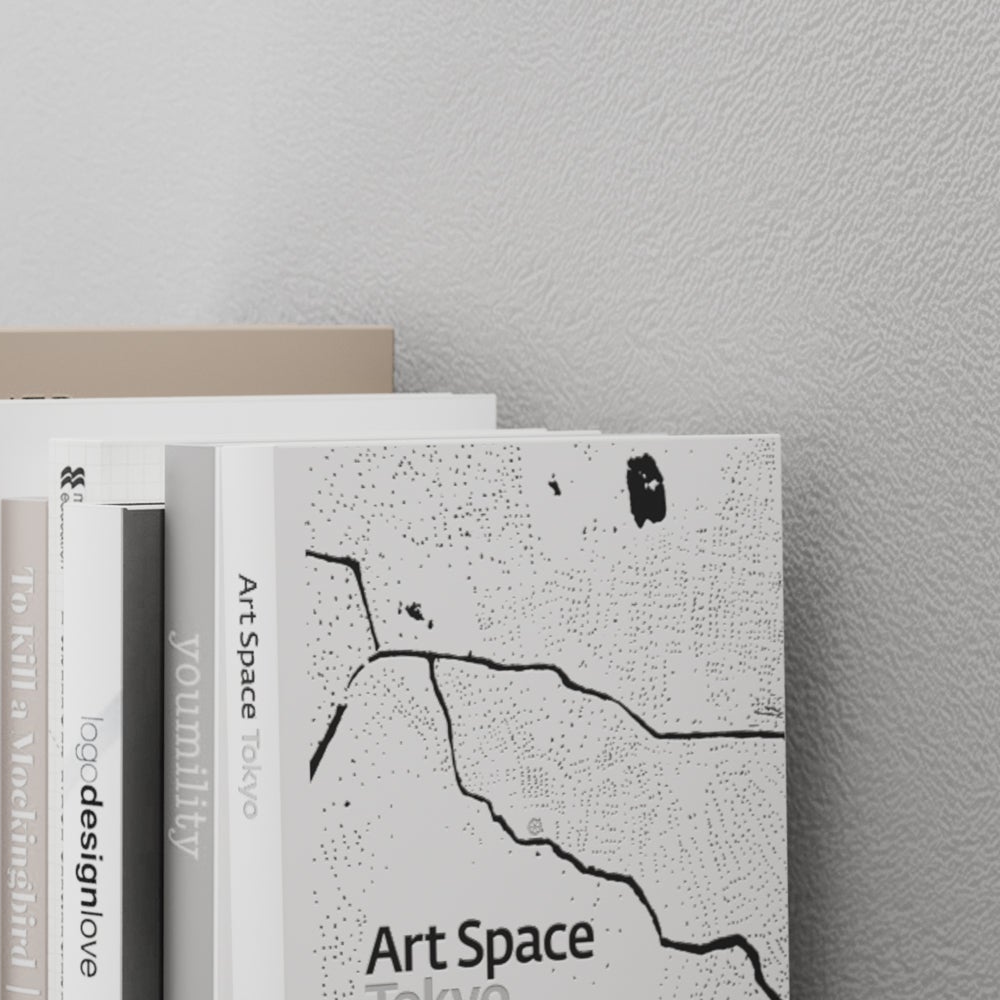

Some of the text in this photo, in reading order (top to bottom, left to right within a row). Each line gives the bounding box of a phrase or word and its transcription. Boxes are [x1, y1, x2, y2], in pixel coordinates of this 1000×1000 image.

[12, 566, 36, 615] To
[237, 573, 262, 821] Art Space Tokyo
[11, 700, 29, 720] a
[168, 630, 209, 862] youmility
[7, 730, 38, 969] Mockingbird
[75, 715, 104, 978] logodesignlove
[366, 918, 595, 980] Art Space
